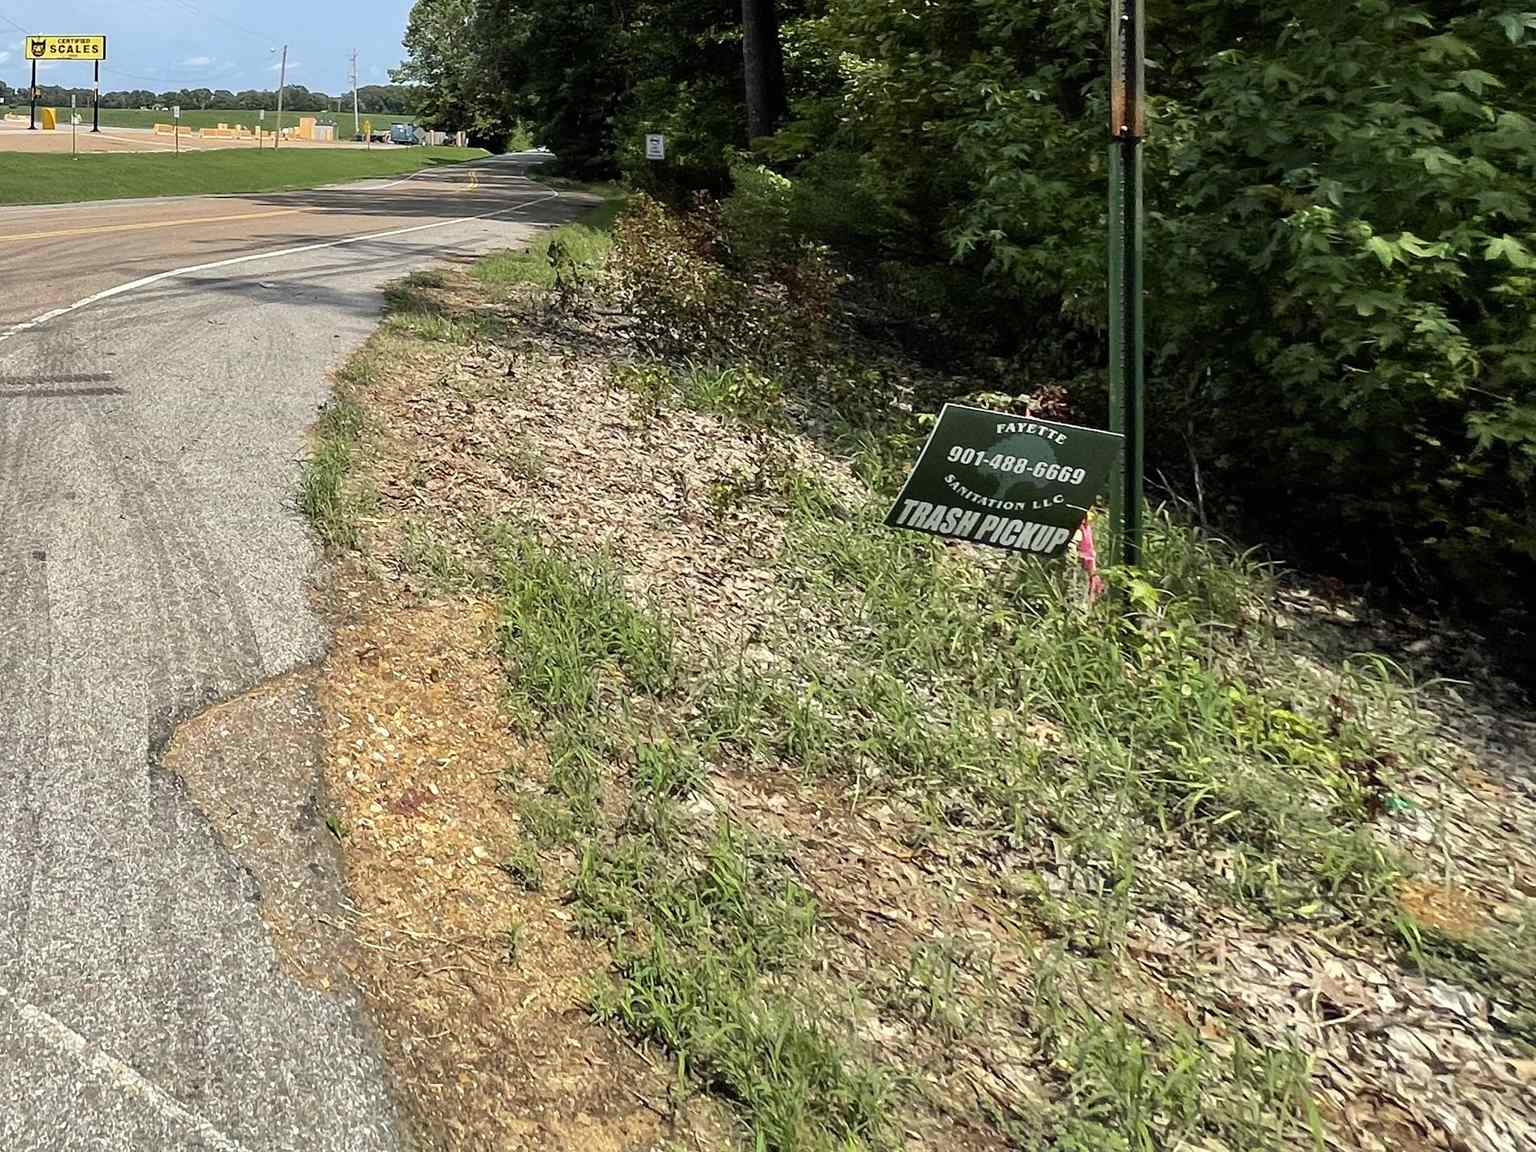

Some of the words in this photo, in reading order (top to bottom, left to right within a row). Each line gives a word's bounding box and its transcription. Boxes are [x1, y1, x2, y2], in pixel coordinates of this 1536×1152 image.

[50, 45, 99, 53] SCALES
[996, 422, 1067, 445] FAYETTE
[947, 445, 1086, 486] 901-488-6669
[944, 472, 1025, 512] SANITATION
[1032, 493, 1065, 510] LLC
[896, 499, 976, 539] TRASH
[975, 515, 1070, 554] PICKUP
